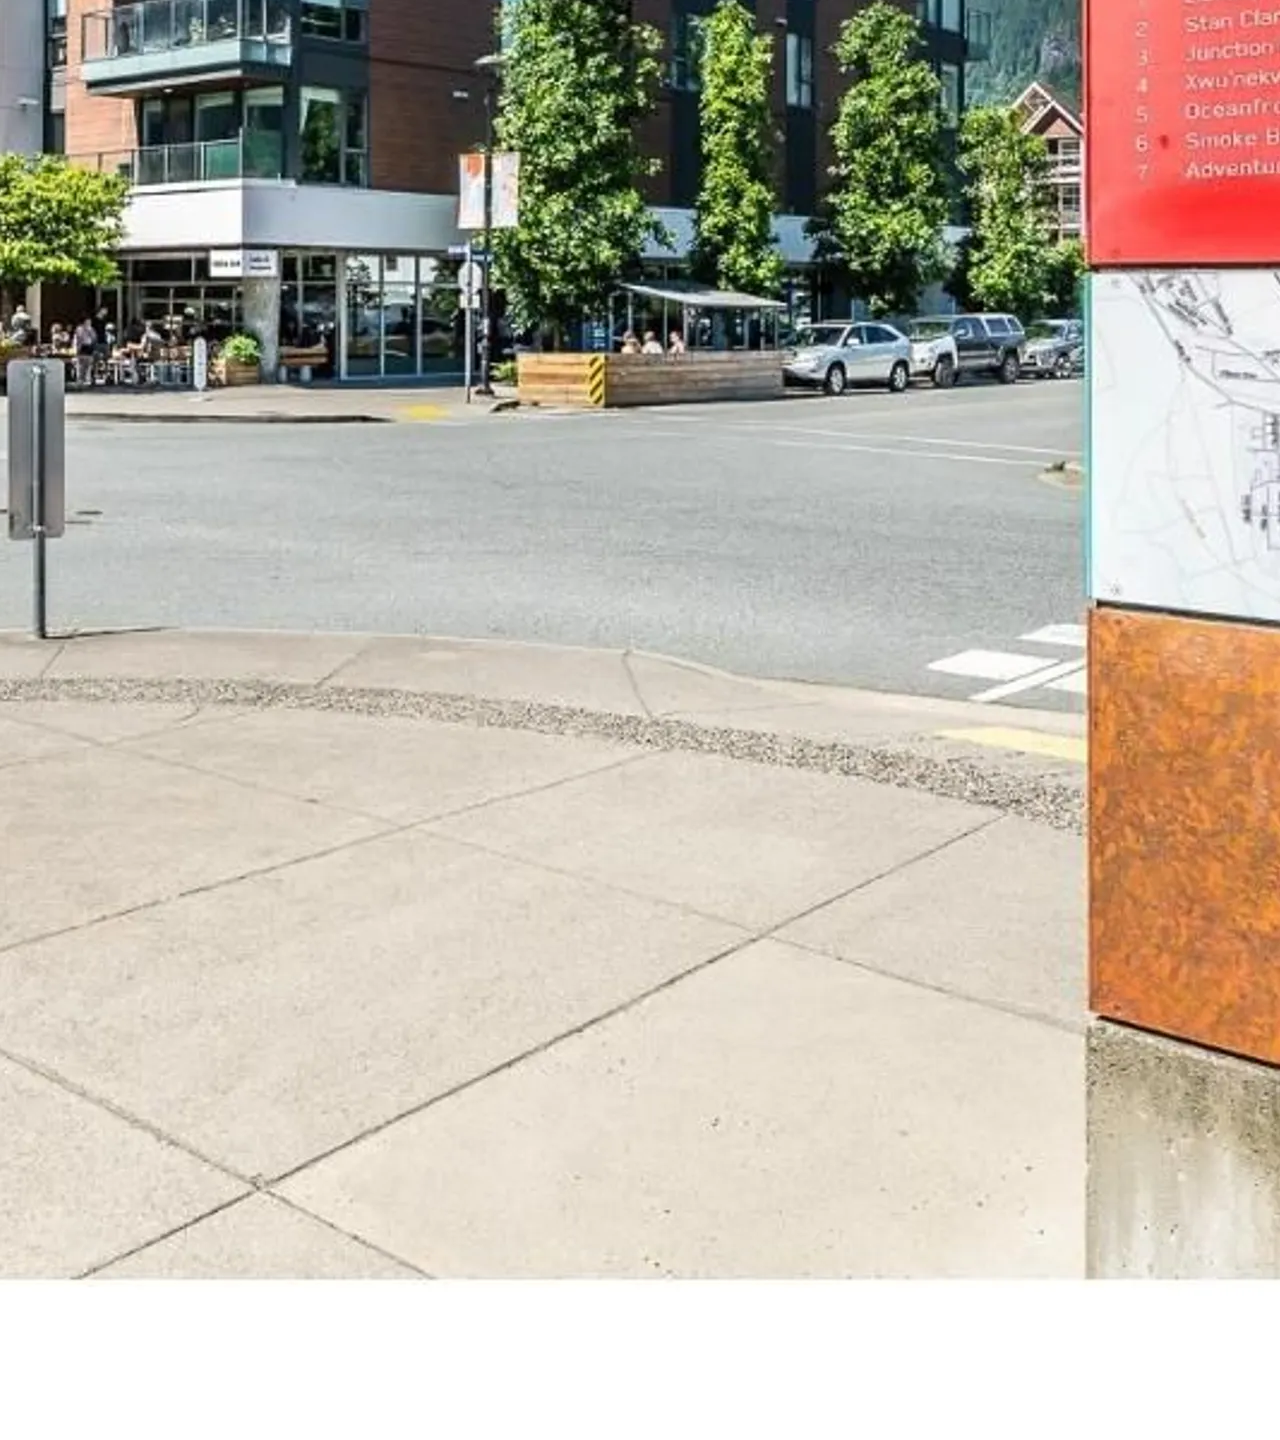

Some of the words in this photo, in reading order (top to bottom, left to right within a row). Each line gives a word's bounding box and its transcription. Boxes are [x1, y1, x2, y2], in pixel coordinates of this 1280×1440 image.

[1135, 22, 1148, 38] 2
[1185, 14, 1232, 33] Stan
[1136, 50, 1148, 66] 3
[1186, 40, 1274, 62] Junction
[1136, 77, 1148, 93] 4
[1136, 107, 1148, 123] 5
[1136, 135, 1148, 152] 6
[1185, 131, 1257, 150] Smoke
